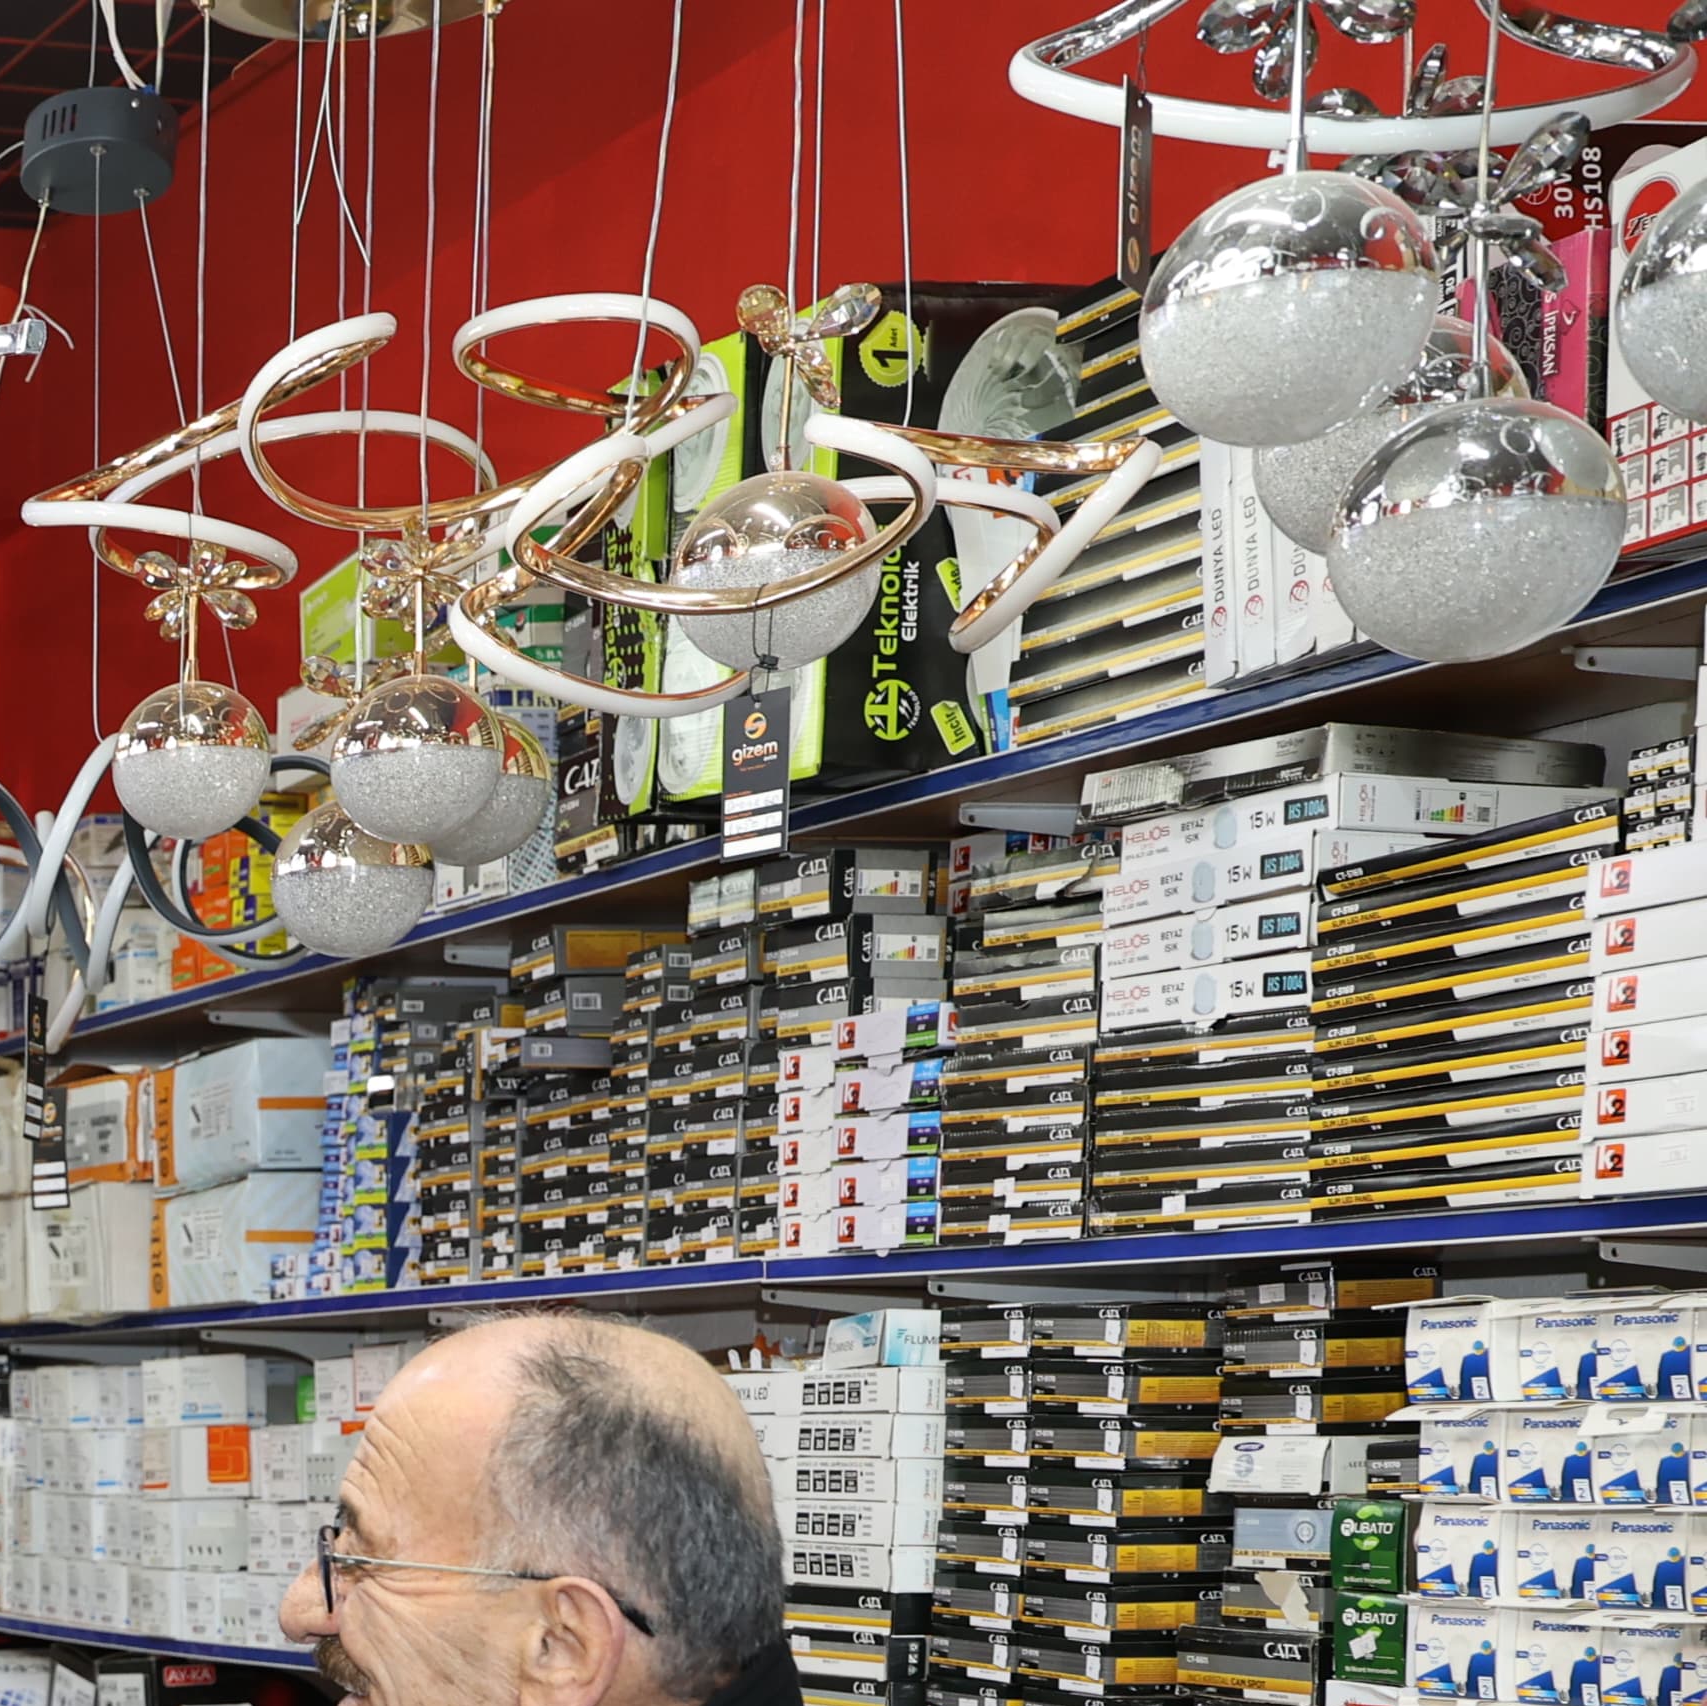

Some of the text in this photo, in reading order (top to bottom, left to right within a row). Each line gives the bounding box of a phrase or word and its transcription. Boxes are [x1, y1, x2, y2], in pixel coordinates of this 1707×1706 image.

[1129, 125, 1142, 225] gizem
[890, 327, 898, 347] Adet
[1242, 496, 1260, 592] DÜNYA LED
[1211, 508, 1225, 603] DÜNYA LED
[901, 561, 920, 642] Elektrik
[732, 741, 779, 767] gizem
[1289, 799, 1325, 818] HS 1004
[1574, 805, 1606, 823] CATA
[1126, 825, 1170, 844] HELIOS
[1181, 819, 1204, 832] BEYAZ
[1264, 854, 1300, 873] HS 1004
[1570, 849, 1601, 867] CATA
[798, 858, 828, 878] CATA
[1160, 873, 1183, 885] BEYAZ
[1106, 879, 1149, 898] HELIOS
[816, 923, 845, 942] CATA
[1262, 915, 1297, 932] HS 1004
[1107, 933, 1150, 952] HELIOS
[1160, 929, 1183, 941] BEYAZ
[719, 937, 742, 953] CATA
[1161, 982, 1184, 994] BEYAZ
[1267, 974, 1303, 992] HS 1004
[817, 985, 847, 1005] CATA
[1106, 985, 1150, 1001] HELIOS
[1420, 1316, 1478, 1330] Panasonic
[1614, 1313, 1679, 1328] Panasonic
[1340, 1518, 1393, 1537] RUBATO
[1434, 1515, 1489, 1528] Panasonic
[1533, 1519, 1594, 1532] Panasonic
[1611, 1522, 1674, 1535] Panasonic
[1342, 1608, 1396, 1627] RUBATO
[1432, 1614, 1486, 1628] Panasonic
[1533, 1621, 1589, 1634] Panasonic
[1264, 1642, 1301, 1661] CATA
